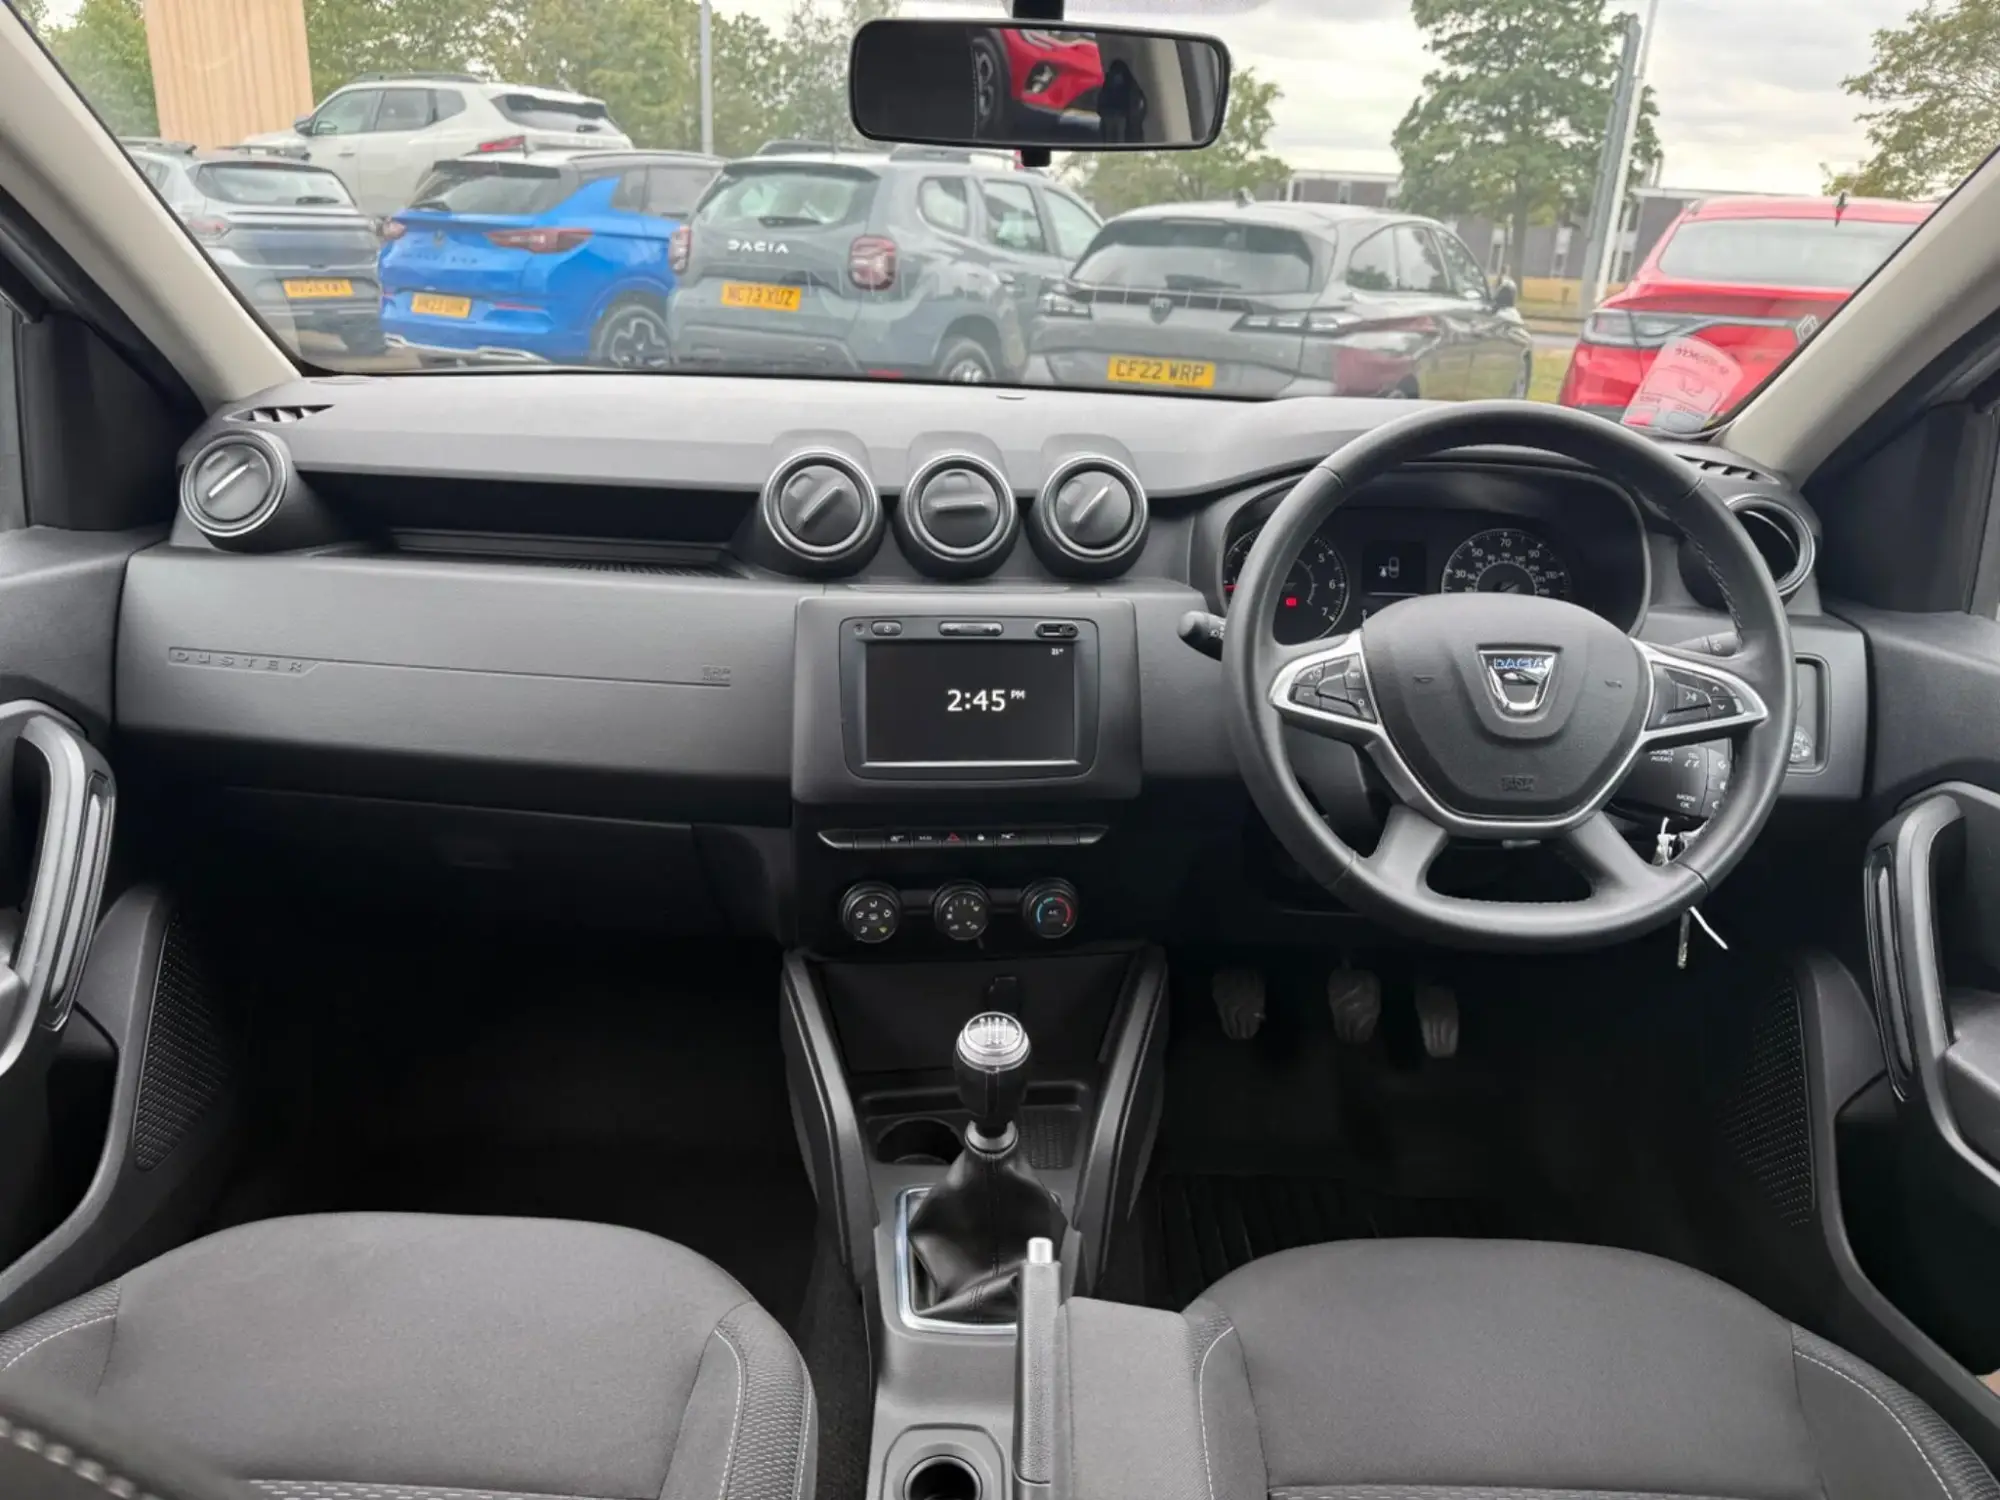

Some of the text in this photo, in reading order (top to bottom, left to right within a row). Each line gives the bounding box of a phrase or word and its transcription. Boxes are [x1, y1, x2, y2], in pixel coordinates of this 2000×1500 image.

[727, 239, 790, 254] DACIA
[1116, 359, 1205, 384] CF22 WRP
[1500, 538, 1512, 548] 70
[1318, 552, 1325, 563] 5
[1471, 548, 1484, 557] 50
[1455, 569, 1467, 579] 30
[1328, 579, 1336, 590] 6
[174, 651, 303, 672] DUSTER
[1493, 657, 1546, 670] DACIA
[947, 688, 1026, 712] 2:45 PM
